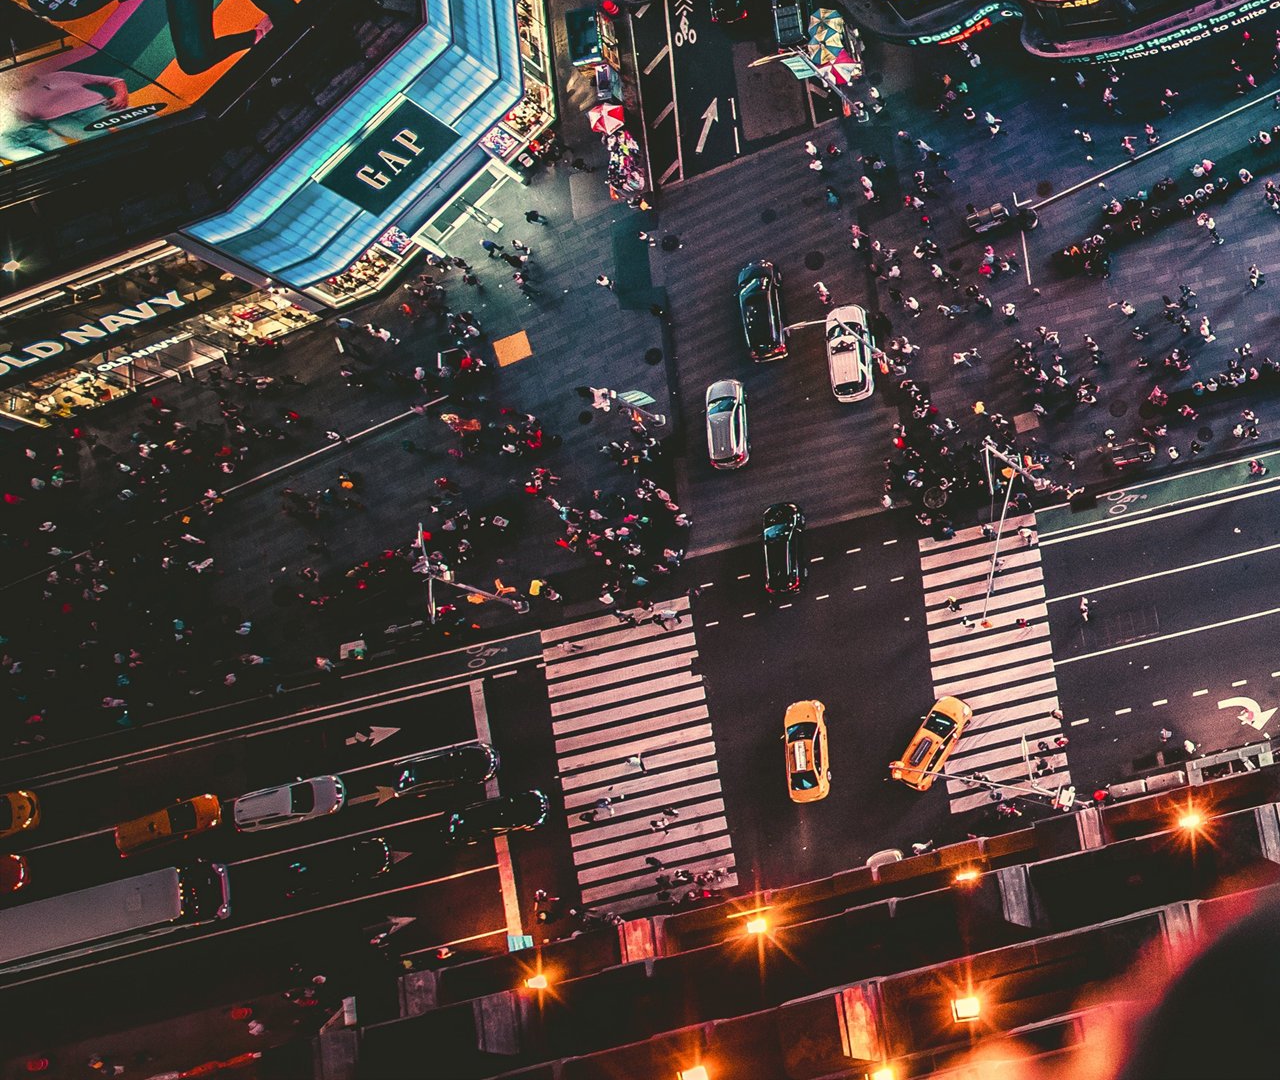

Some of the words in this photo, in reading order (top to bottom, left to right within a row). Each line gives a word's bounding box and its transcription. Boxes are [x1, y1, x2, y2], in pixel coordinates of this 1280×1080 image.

[963, 2, 1001, 29] actor
[1095, 44, 1145, 61] played
[1147, 18, 1208, 50] Hershel,
[1209, 9, 1237, 25] has
[1161, 31, 1212, 52] helped
[1212, 23, 1229, 34] to
[1231, 7, 1267, 27] unite
[93, 117, 122, 130] OLD
[123, 104, 158, 122] NAVY
[353, 127, 426, 192] GAP
[60, 290, 188, 346] NAVY
